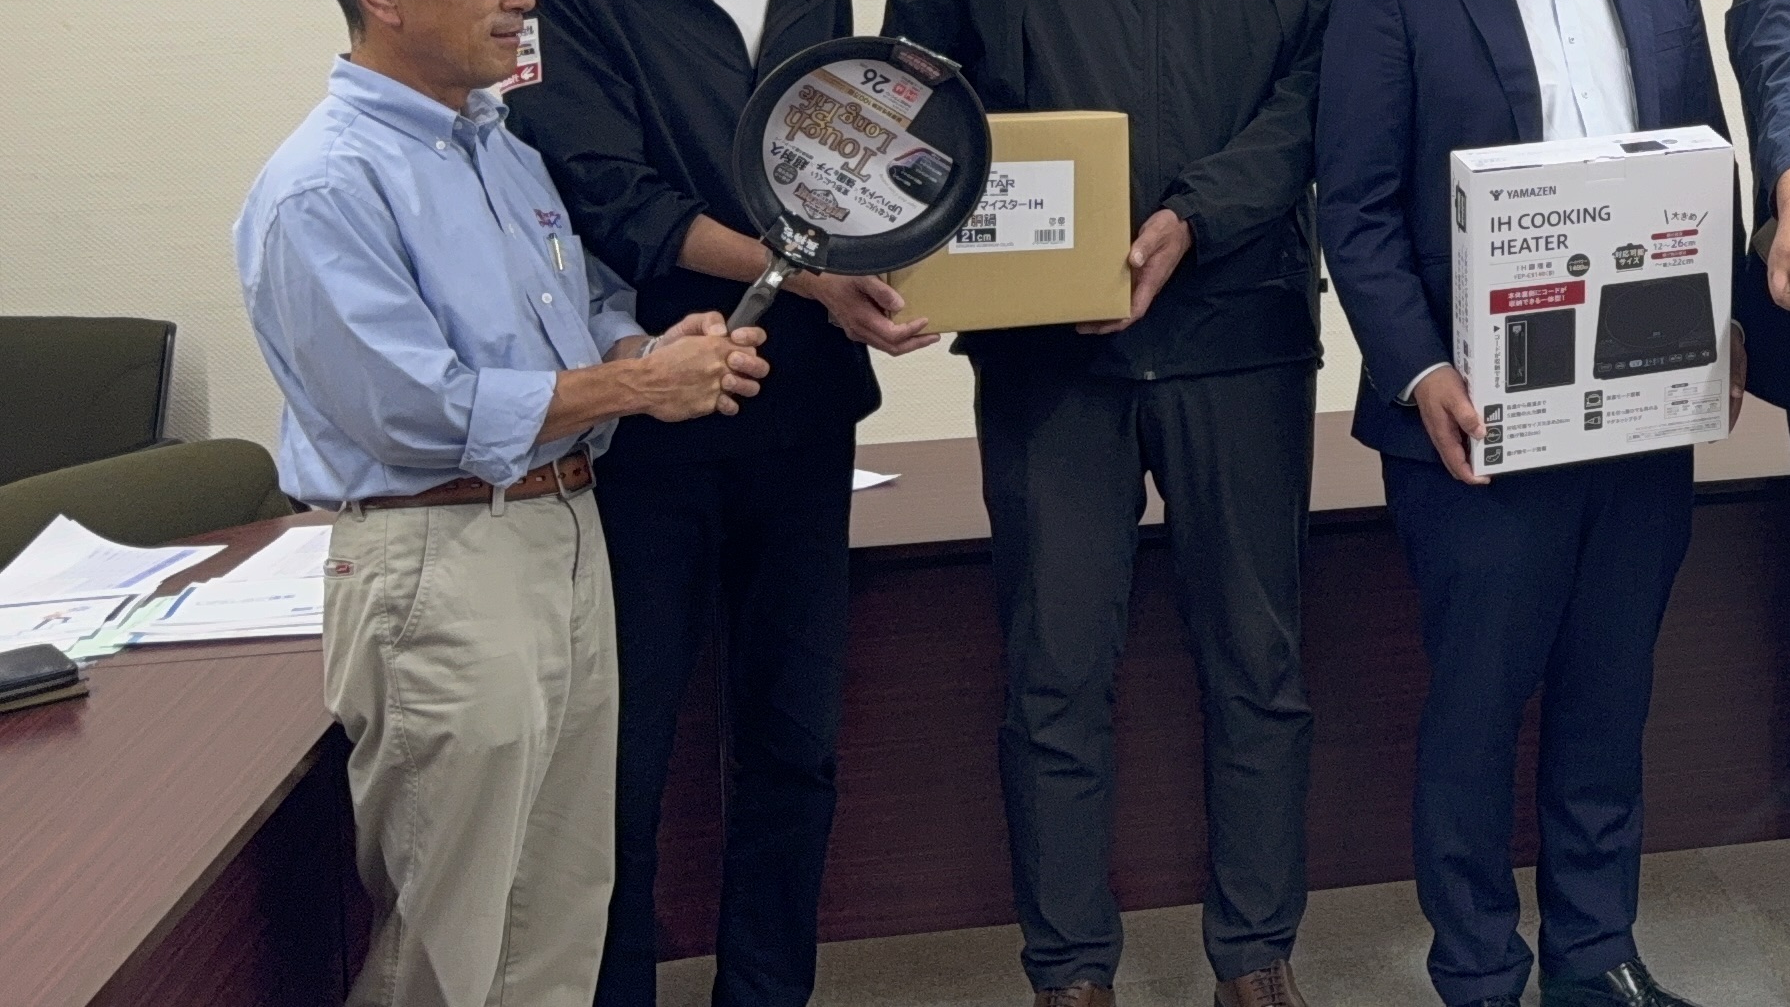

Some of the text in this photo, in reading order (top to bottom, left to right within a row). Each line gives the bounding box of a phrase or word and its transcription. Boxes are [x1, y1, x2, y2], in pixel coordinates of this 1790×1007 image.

[859, 68, 892, 96] 26
[798, 85, 844, 124] Life
[838, 102, 898, 155] Long
[769, 141, 808, 173] 超耐久
[785, 105, 878, 183] Tough
[857, 184, 904, 216] UPハンドル
[977, 199, 1044, 210] マイスターIH
[1507, 186, 1556, 199] YAMAZEN
[1491, 205, 1611, 233] IH COOKING
[961, 230, 992, 242] 21cm
[1491, 234, 1569, 257] HEATER
[1619, 257, 1640, 266] サイズ
